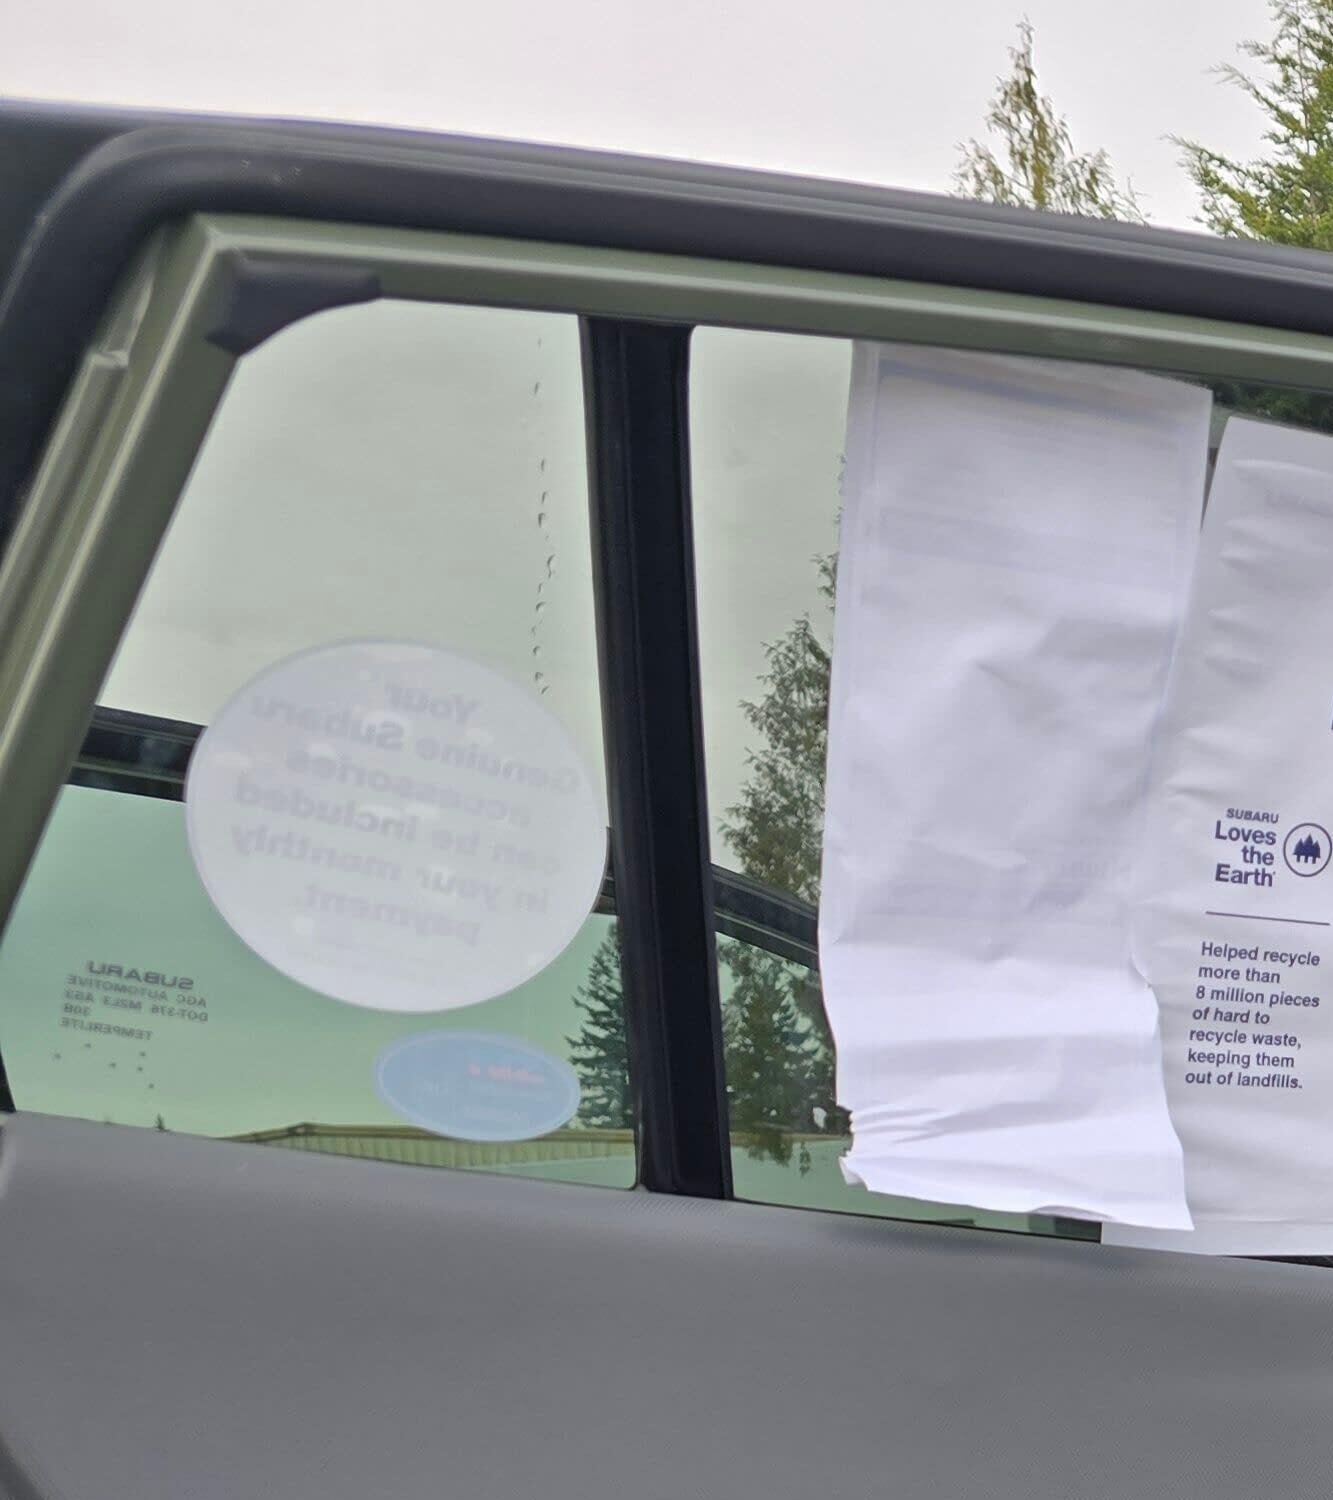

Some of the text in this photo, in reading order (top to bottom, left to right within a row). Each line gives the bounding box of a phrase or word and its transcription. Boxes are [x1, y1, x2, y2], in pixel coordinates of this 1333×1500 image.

[1227, 808, 1279, 824] SUBARU
[1215, 820, 1276, 845] Loves
[1241, 846, 1274, 866] the
[1202, 942, 1320, 967] Helped recycle
[1199, 967, 1280, 984] more than
[1196, 985, 1320, 1008] 8 million pieces
[1192, 1007, 1270, 1024] of hard to
[1190, 1029, 1301, 1048] recycle waste,
[1188, 1048, 1294, 1069] keeping them
[1185, 1072, 1302, 1088] out of landfills.
